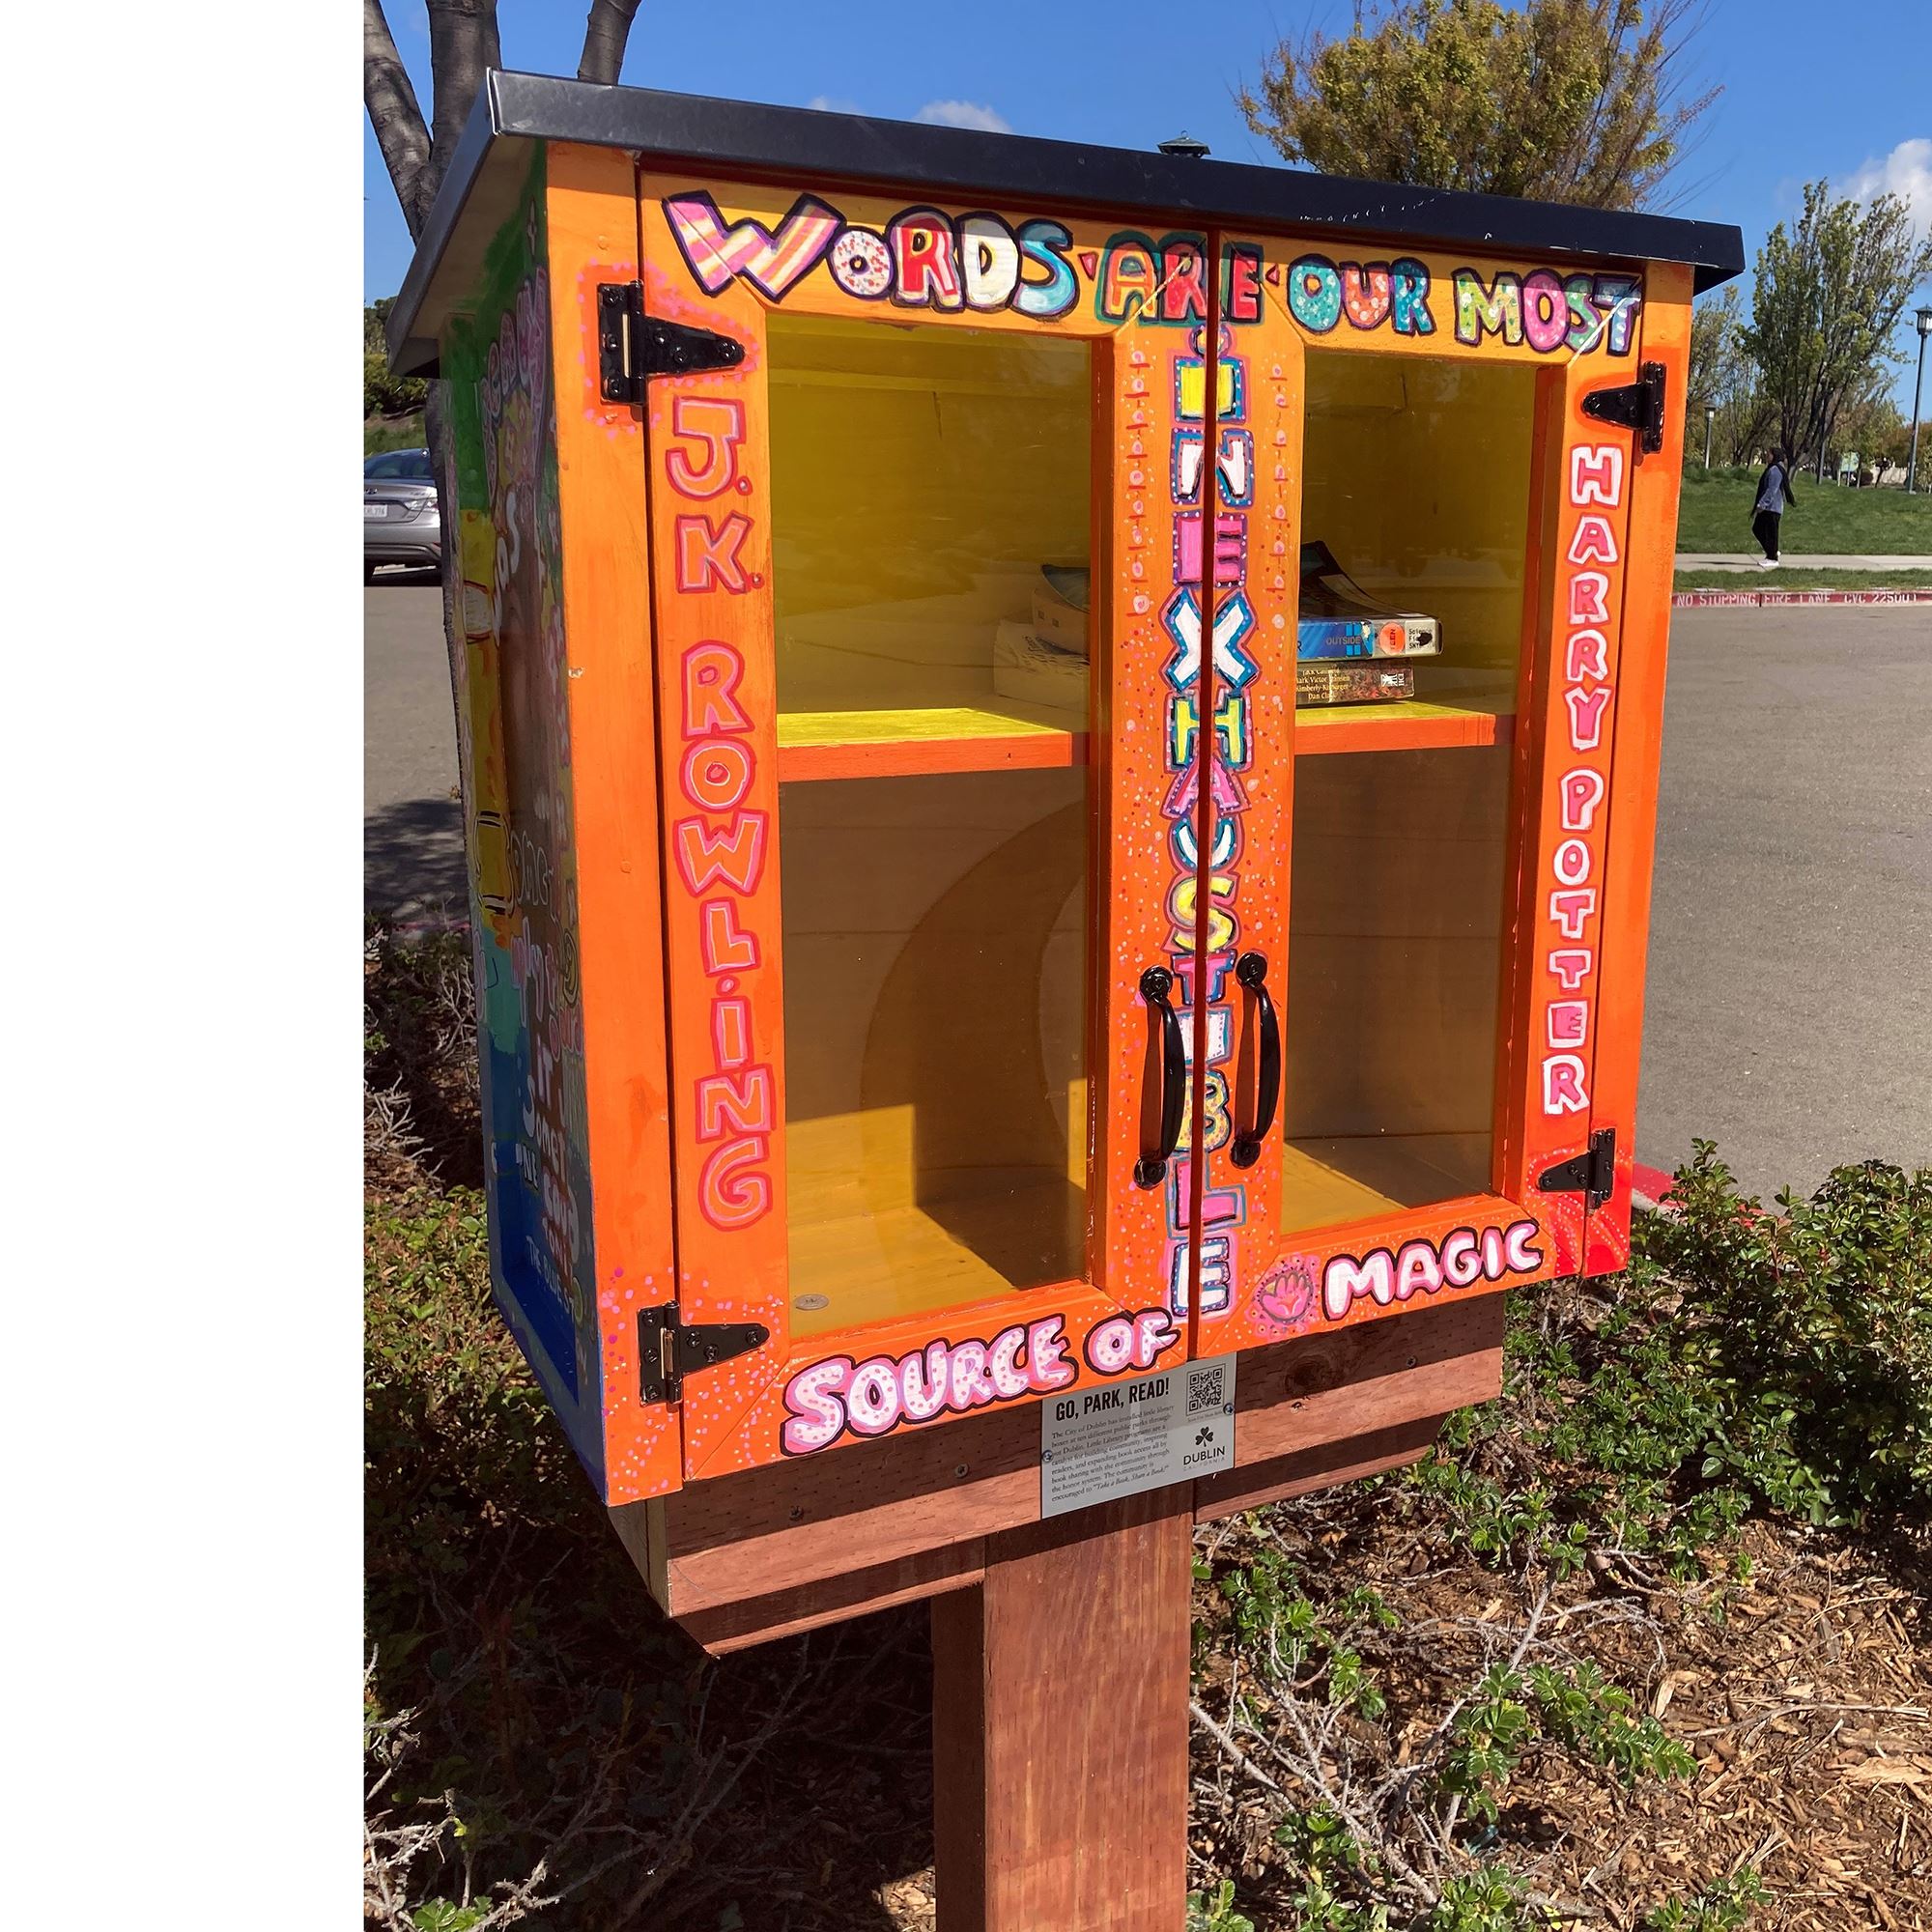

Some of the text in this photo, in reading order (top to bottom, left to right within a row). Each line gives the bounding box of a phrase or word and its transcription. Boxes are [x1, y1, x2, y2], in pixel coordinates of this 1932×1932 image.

[661, 190, 1642, 356] WORDS ARE OUR MOST
[1677, 594, 1693, 607] NO
[1699, 593, 1756, 607] STOPPING
[1844, 593, 1866, 604] CVC
[1325, 637, 1362, 645] OUTSIDE
[1542, 443, 1622, 1118] HARRY POTTER
[1321, 1217, 1545, 1321] MAGIC
[780, 1307, 1181, 1457] SOURCE OF
[1055, 1377, 1171, 1422] GO, PARK, READ!
[1183, 1445, 1225, 1465] DUBLIN
